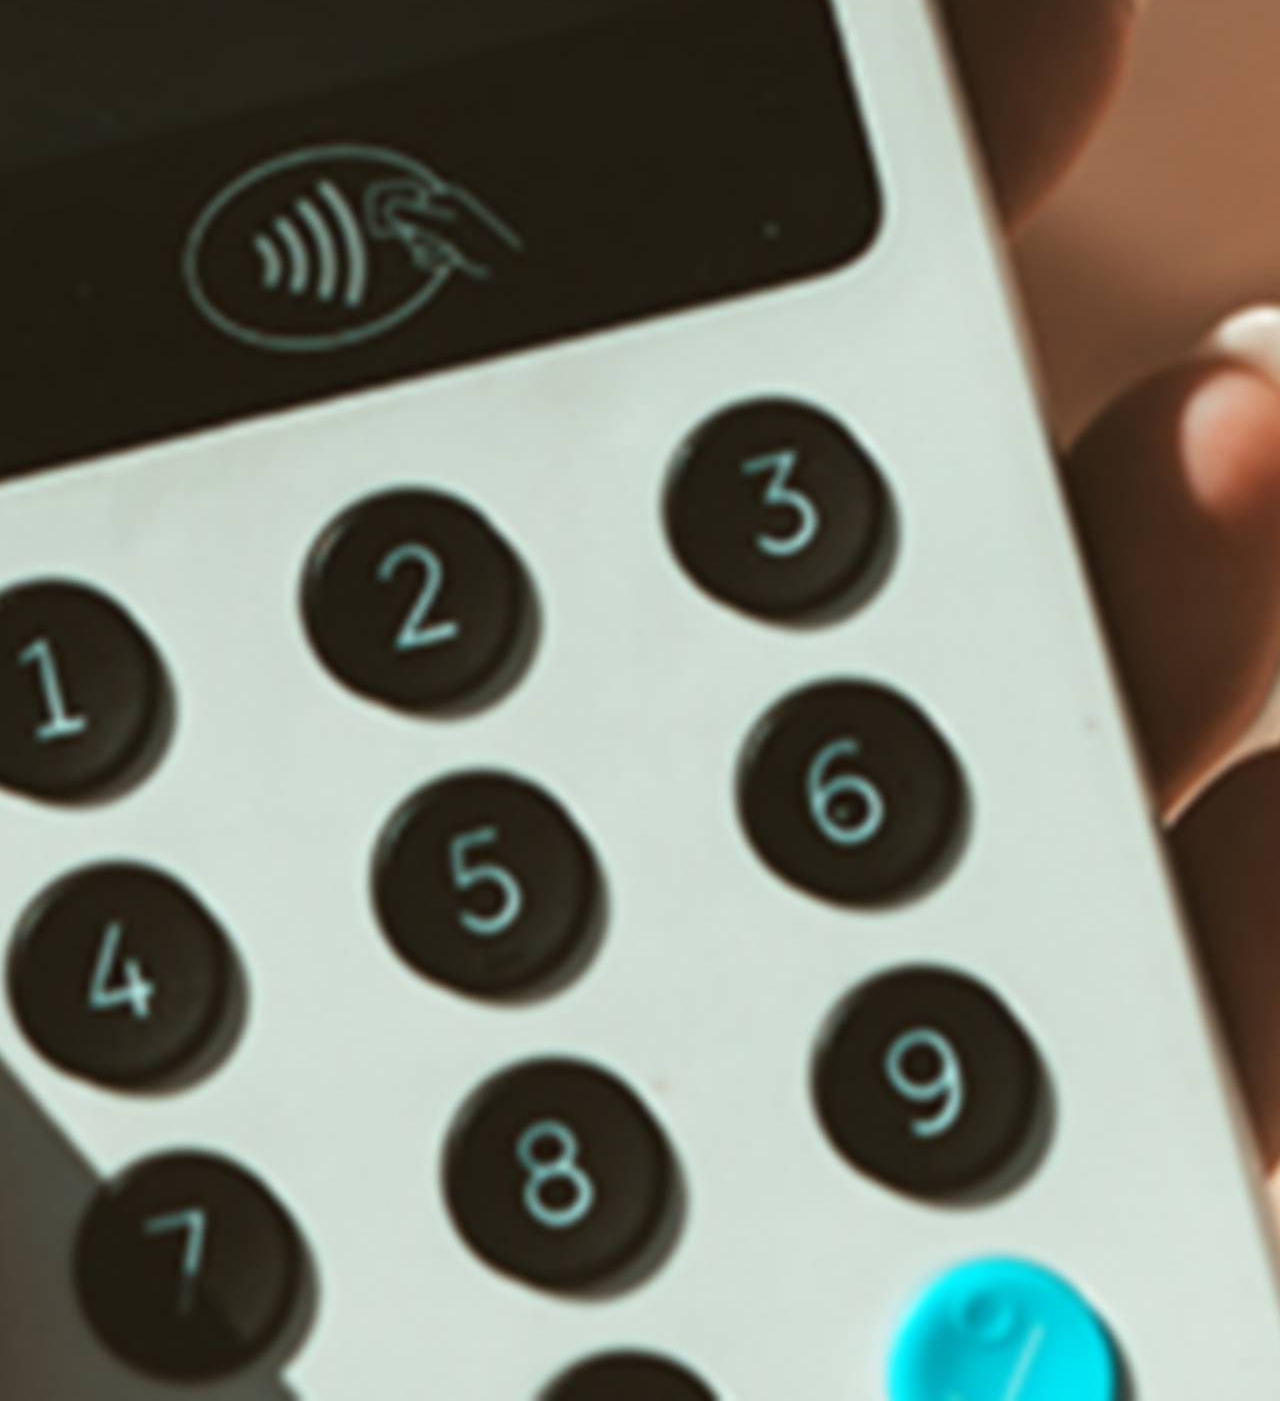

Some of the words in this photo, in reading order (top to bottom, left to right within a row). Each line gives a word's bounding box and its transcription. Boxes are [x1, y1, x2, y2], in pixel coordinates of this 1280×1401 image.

[743, 450, 820, 557] 3
[379, 543, 459, 650] 2
[20, 639, 88, 741] 1
[807, 739, 885, 846] 6
[450, 827, 523, 936] 5
[88, 922, 156, 1020] 4
[884, 1028, 965, 1139] 9
[516, 1120, 595, 1228] 8
[144, 1206, 207, 1315] 7
